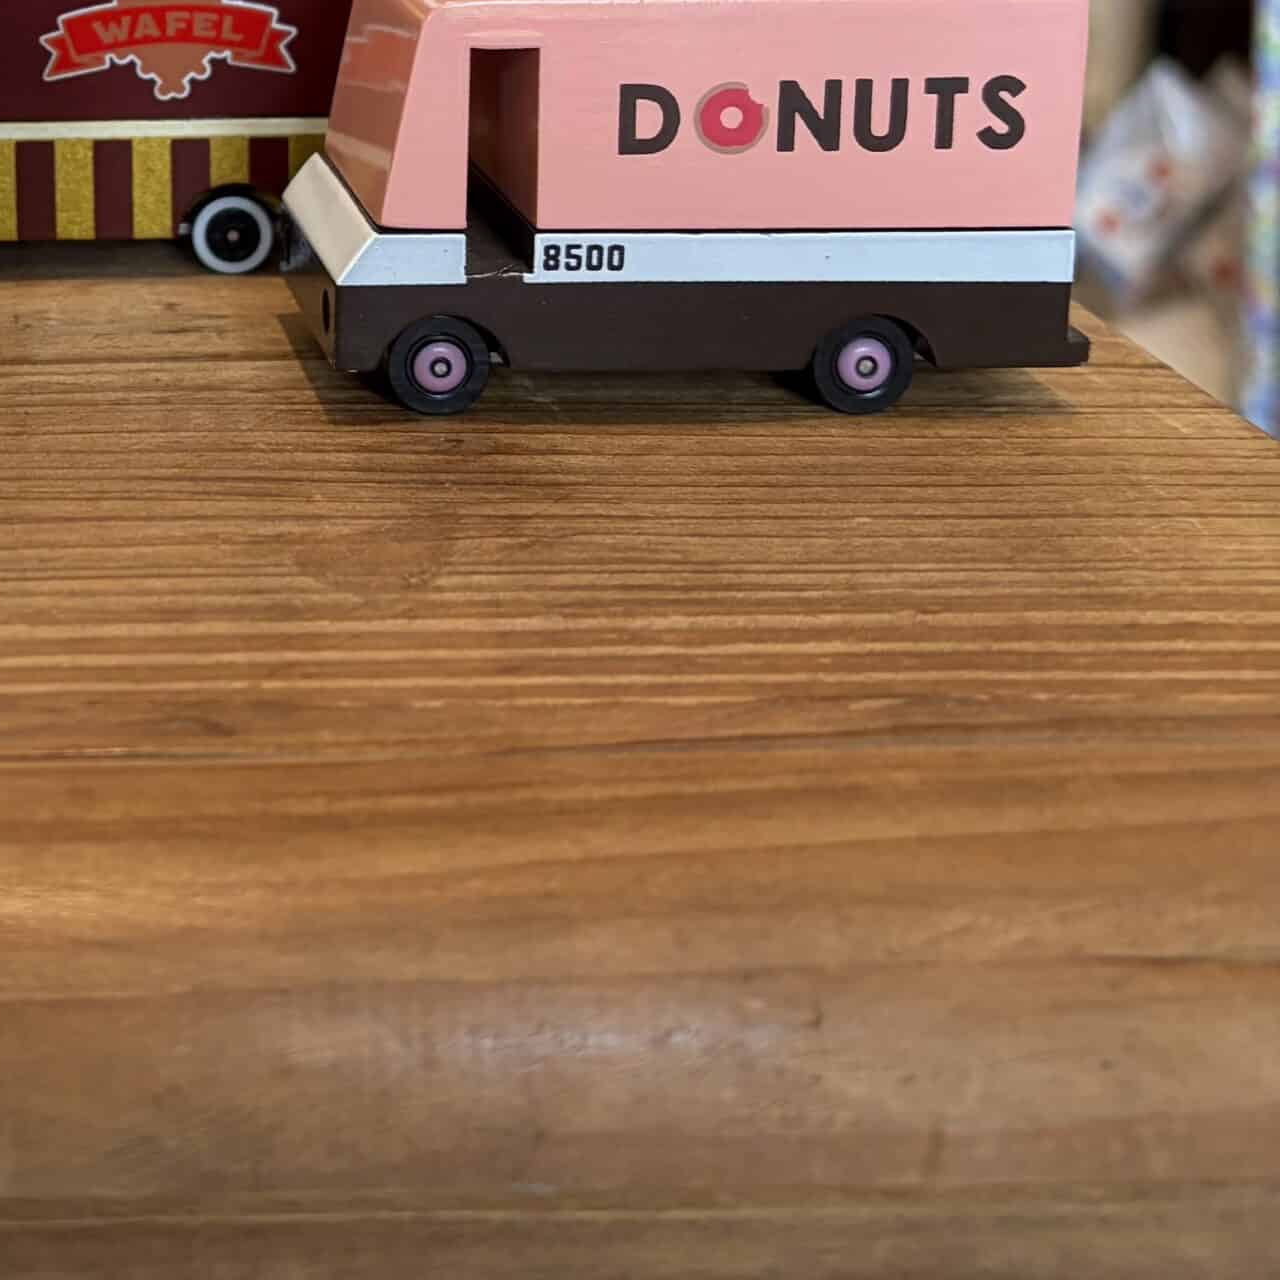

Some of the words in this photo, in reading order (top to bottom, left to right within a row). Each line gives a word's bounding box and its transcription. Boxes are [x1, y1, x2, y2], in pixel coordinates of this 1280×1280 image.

[92, 11, 244, 44] WAFEL
[618, 74, 1028, 156] DONUTS
[542, 244, 626, 272] 8500
